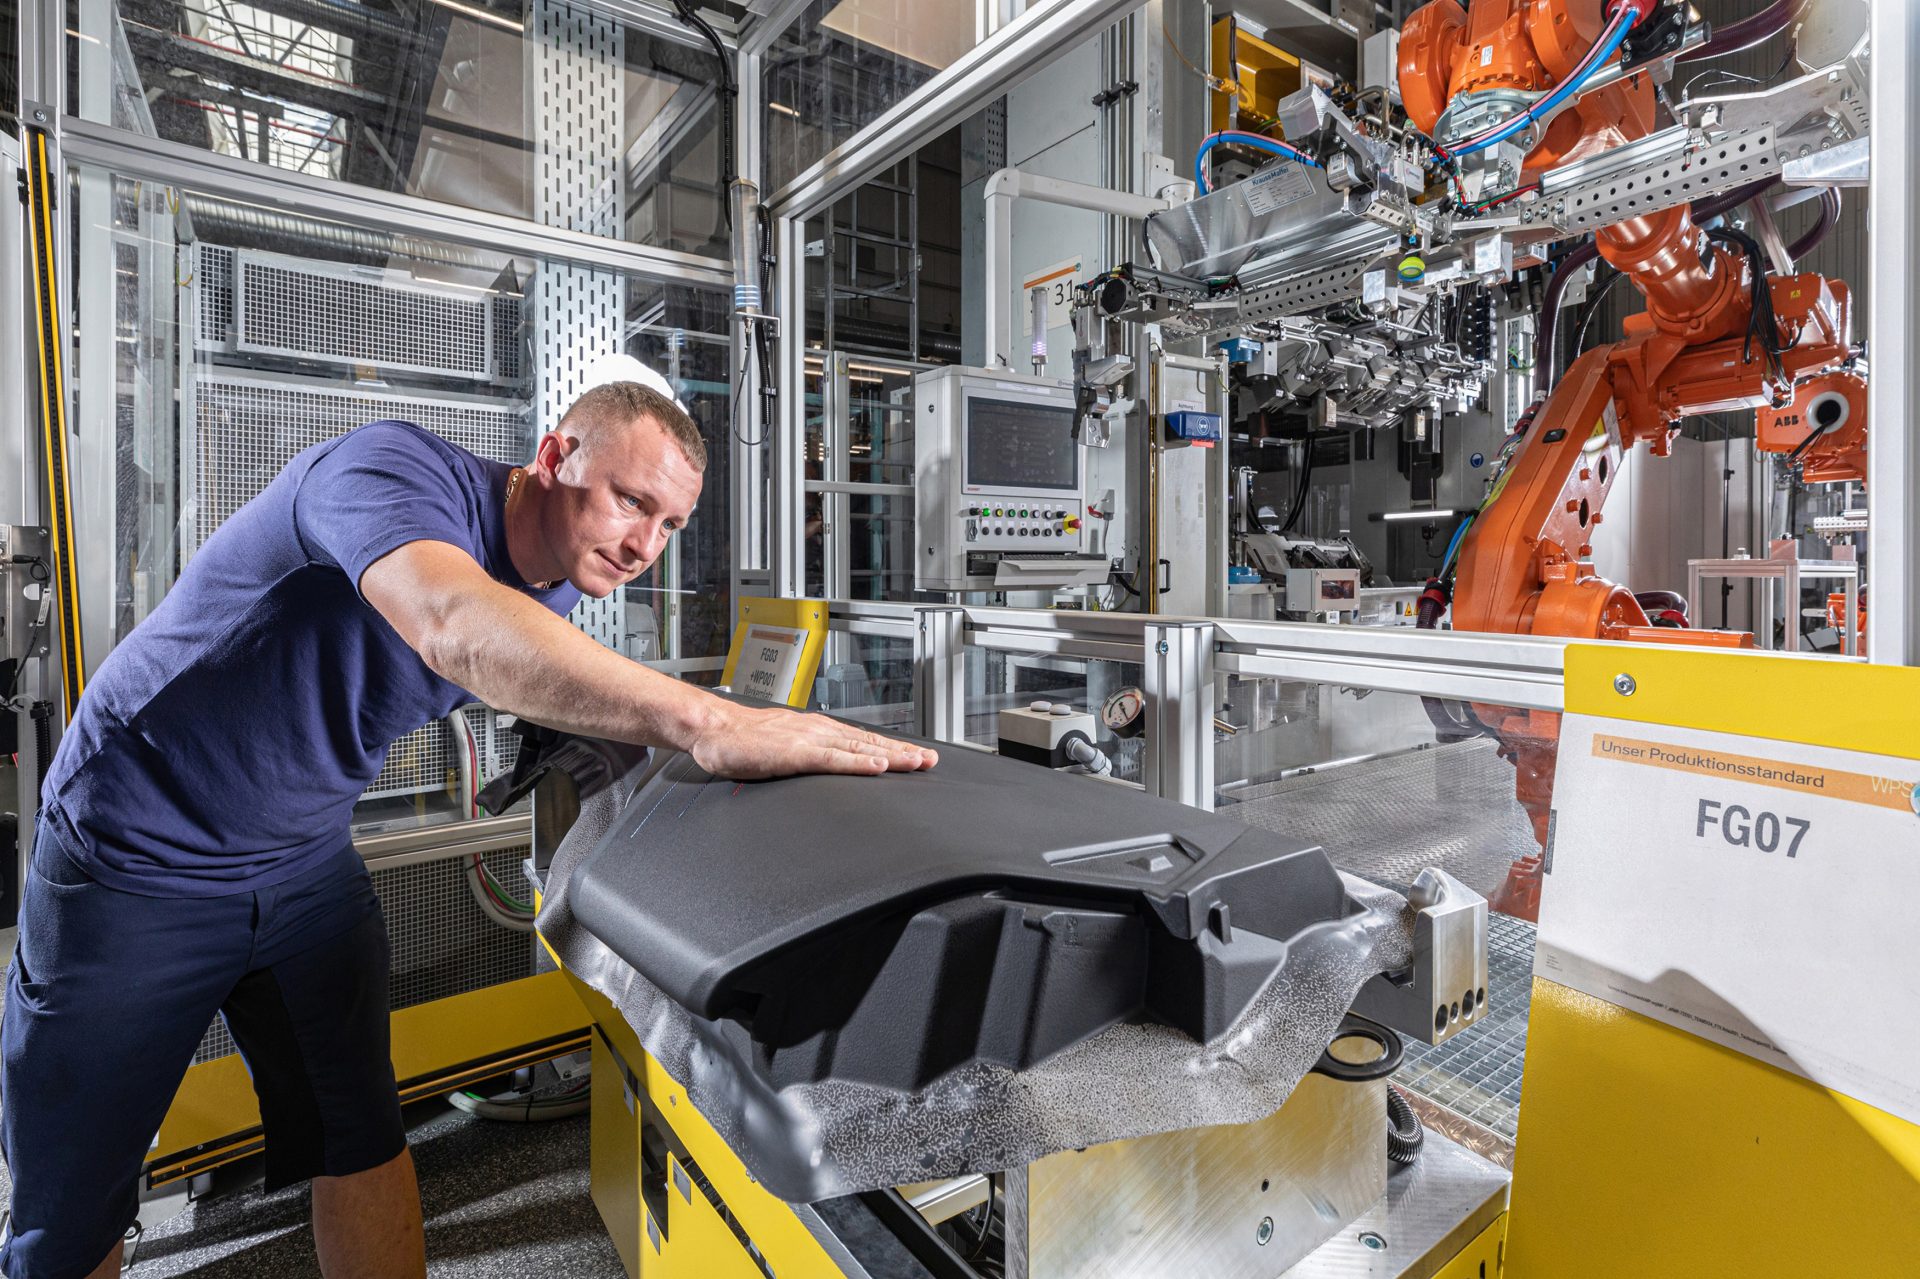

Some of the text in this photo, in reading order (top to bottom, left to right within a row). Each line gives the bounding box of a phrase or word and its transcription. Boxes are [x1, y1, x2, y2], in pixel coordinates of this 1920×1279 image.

[1054, 279, 1074, 306] 31
[1774, 415, 1799, 428] ABB
[761, 647, 779, 663] FG03
[751, 669, 776, 688] +WP001
[1601, 740, 1911, 799] Unser Produktionsstandard WPS
[1696, 798, 1811, 859] FG07
